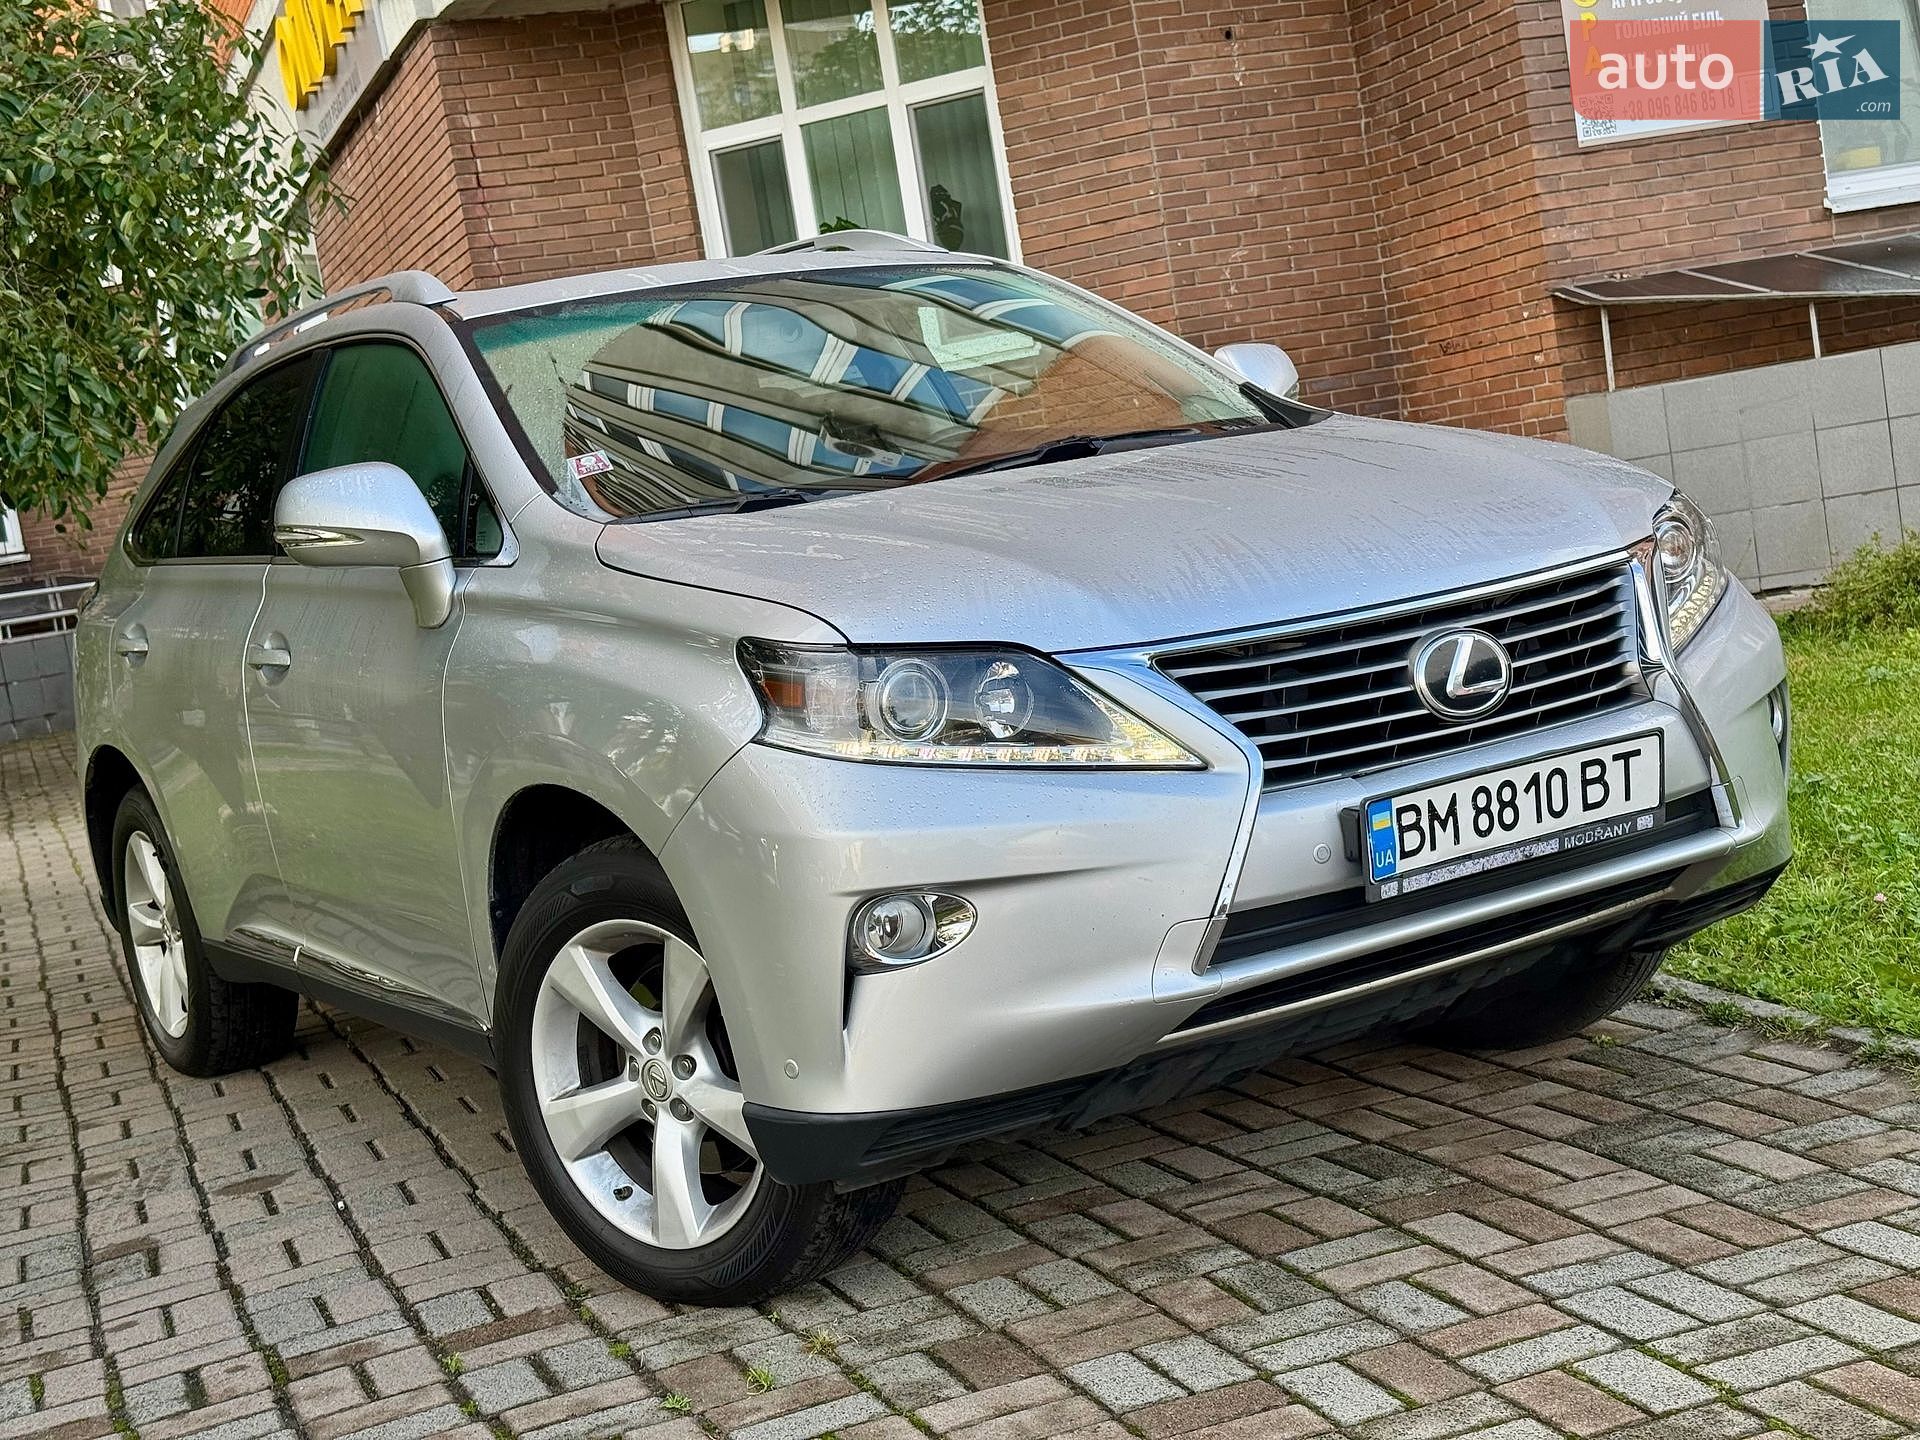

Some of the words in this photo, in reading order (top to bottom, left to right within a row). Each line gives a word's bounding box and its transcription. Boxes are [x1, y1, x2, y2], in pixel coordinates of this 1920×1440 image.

[1647, 95, 1671, 118] 096
[1675, 92, 1698, 115] 846
[1396, 792, 1460, 860] BM
[1471, 767, 1569, 838] 8810
[1580, 749, 1642, 812] BT
[1375, 849, 1394, 867] UA
